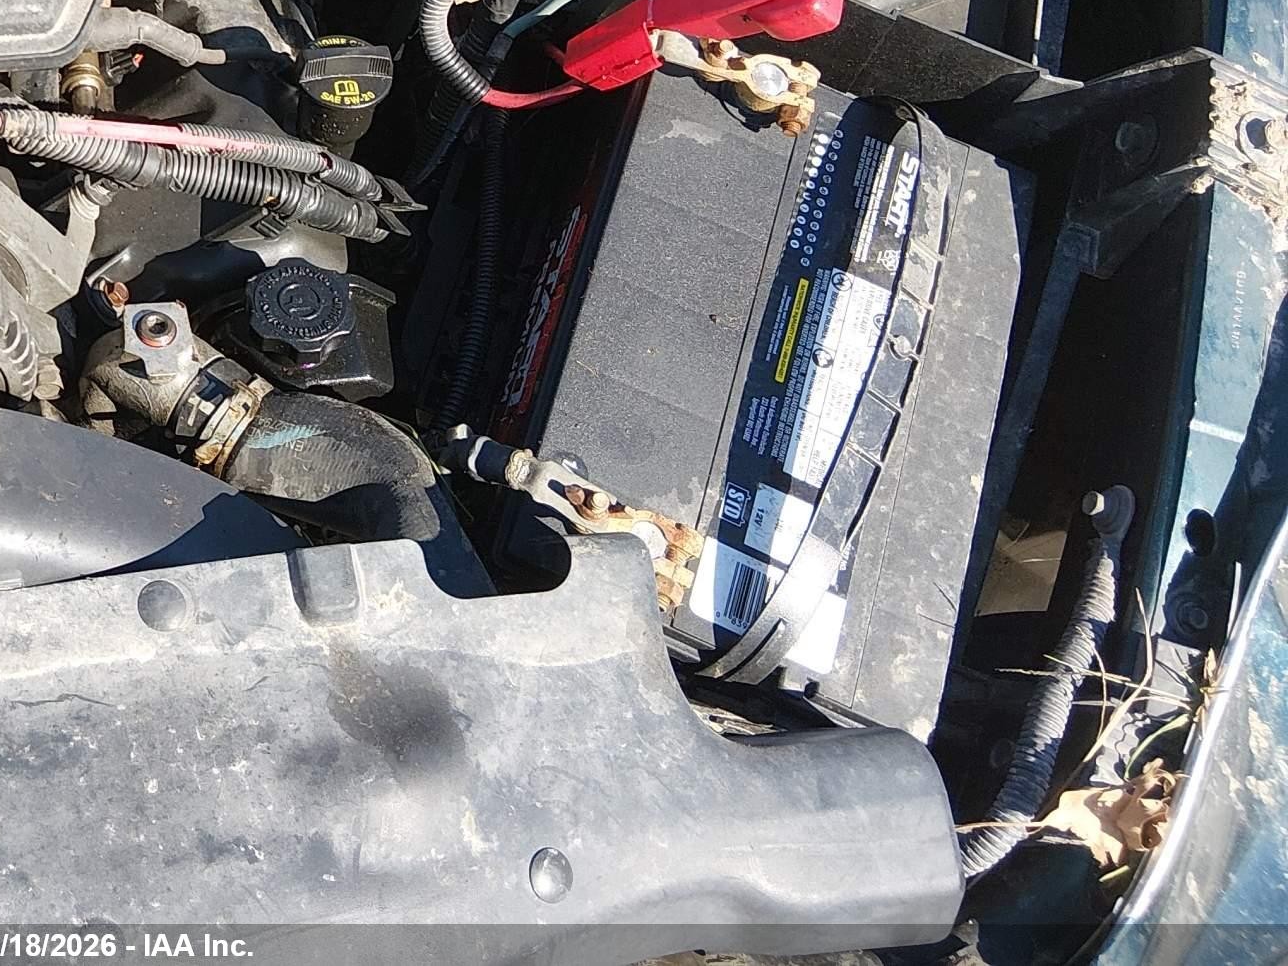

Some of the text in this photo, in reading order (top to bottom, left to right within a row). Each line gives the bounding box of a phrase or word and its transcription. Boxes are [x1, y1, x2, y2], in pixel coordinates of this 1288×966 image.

[320, 91, 375, 105] SAE 5W-20
[888, 151, 920, 236] START
[806, 277, 821, 313] RECOMMENDED
[804, 322, 818, 349] EXPLOSION
[723, 487, 745, 518] STD
[753, 506, 764, 527] 12V
